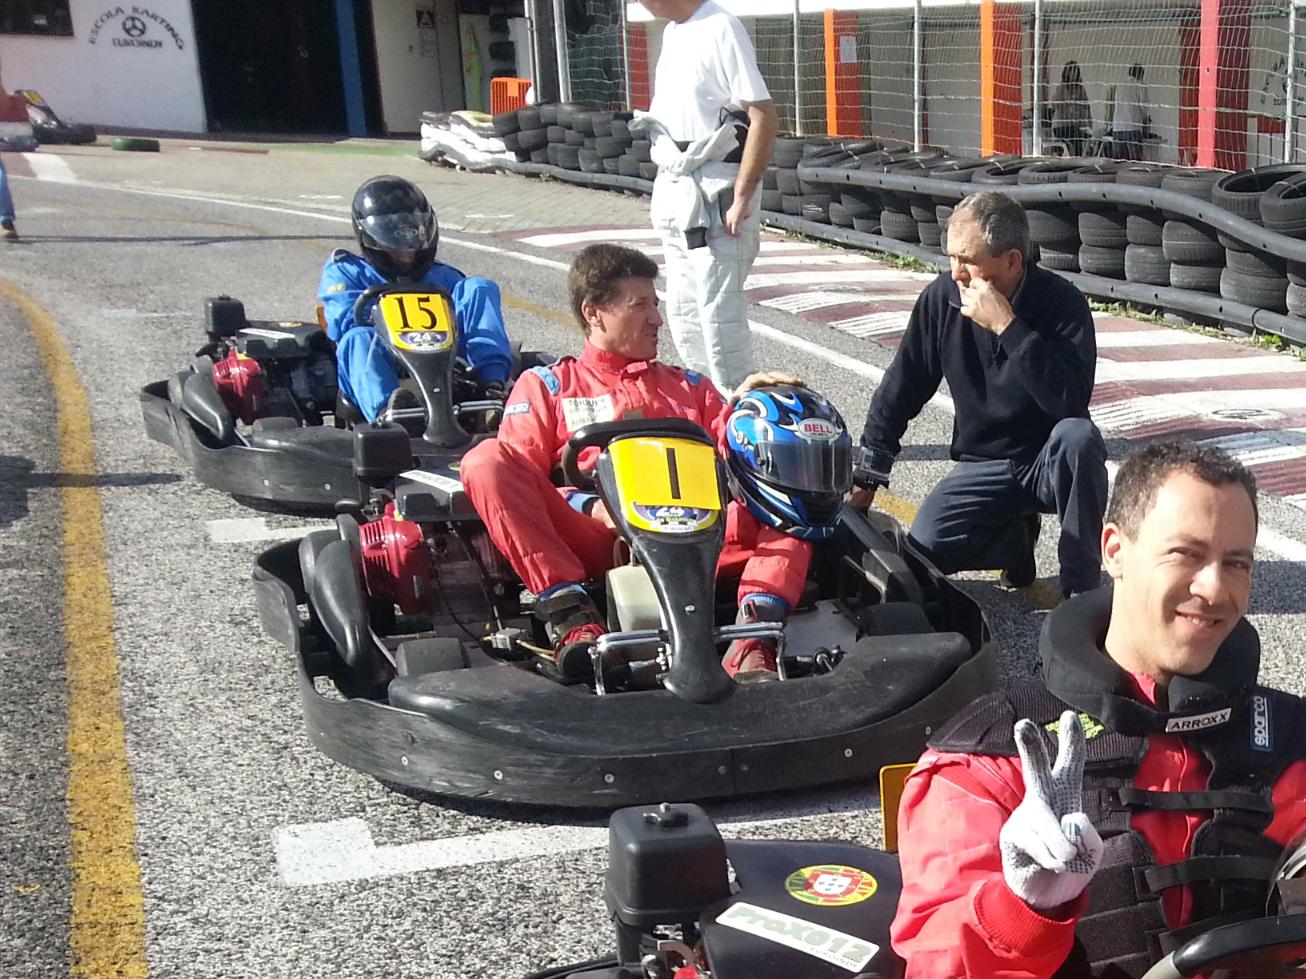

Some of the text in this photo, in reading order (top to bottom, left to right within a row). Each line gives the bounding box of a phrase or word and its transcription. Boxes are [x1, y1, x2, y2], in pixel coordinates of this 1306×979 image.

[88, 6, 184, 50] ESCOLA KARTING
[394, 296, 437, 330] 15
[803, 423, 833, 434] BELL
[666, 447, 681, 500] 1
[1170, 711, 1229, 730] ARROXX
[1253, 695, 1268, 746] sparco
